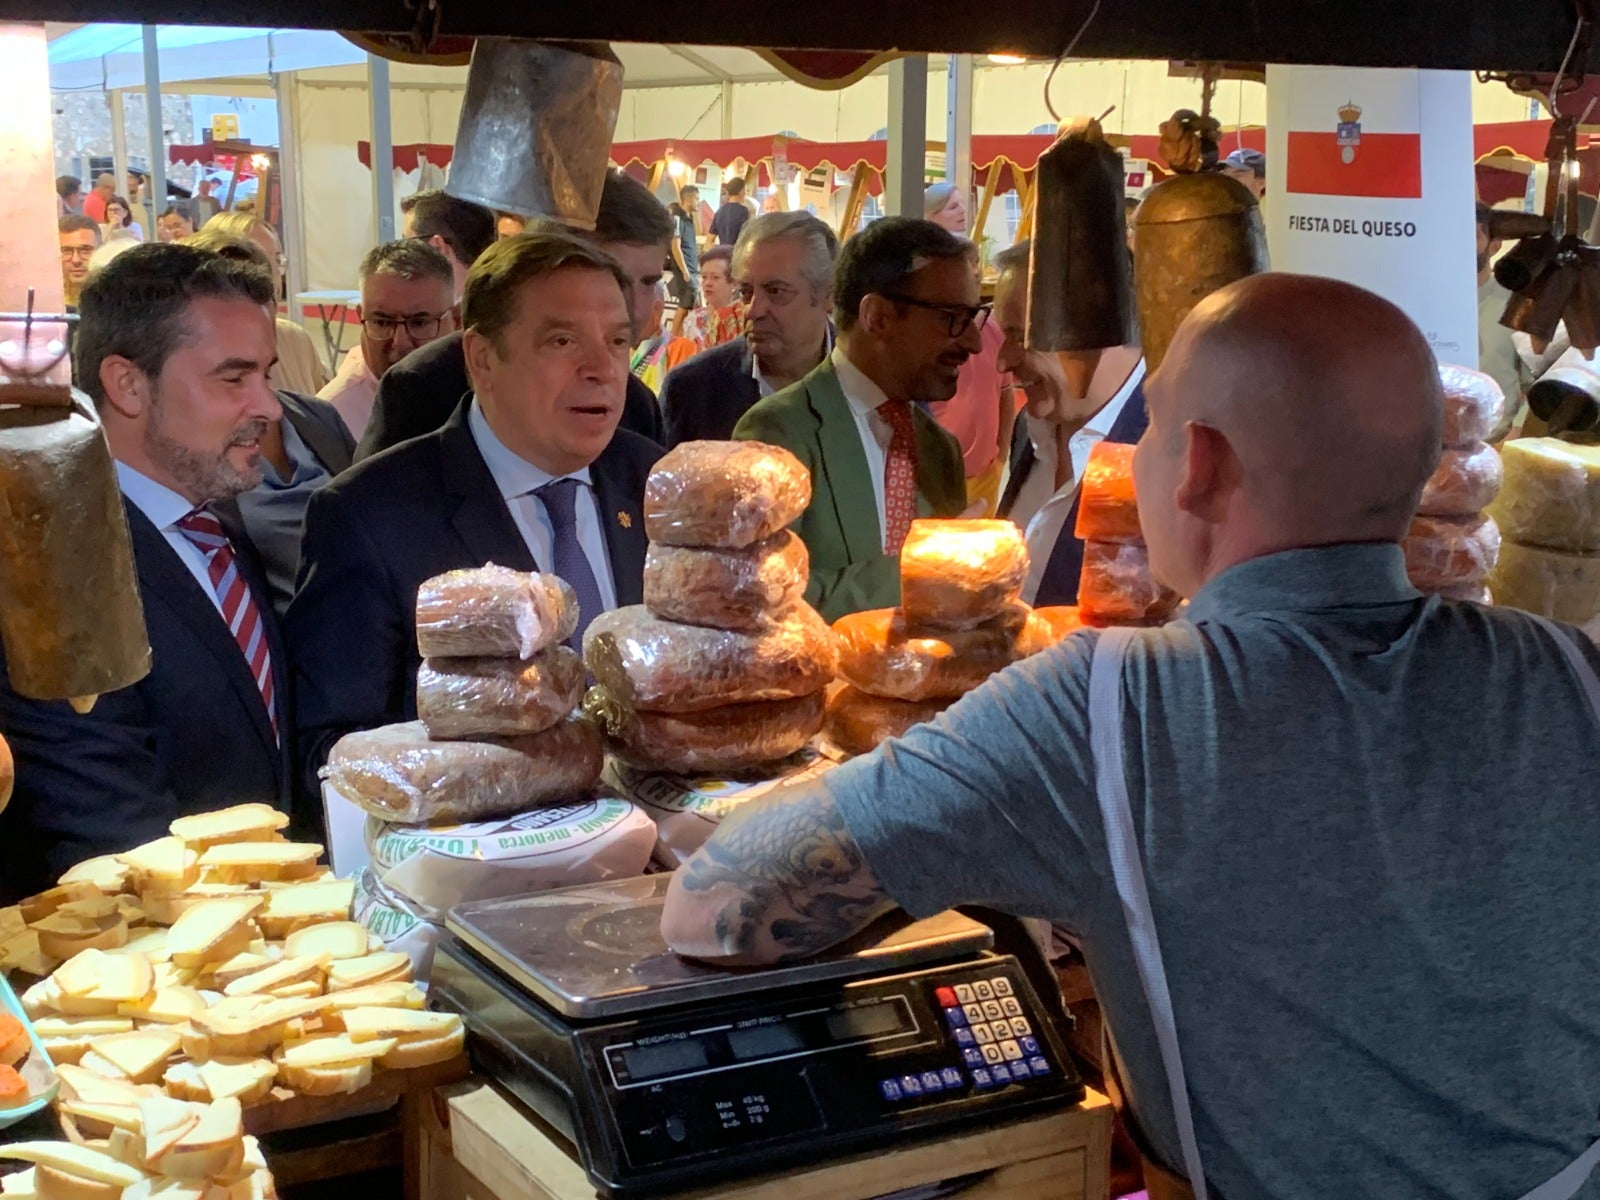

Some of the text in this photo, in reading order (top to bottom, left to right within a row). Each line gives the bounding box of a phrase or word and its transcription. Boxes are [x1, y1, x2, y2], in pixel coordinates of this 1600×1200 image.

[1289, 215, 1417, 237] FIESTA DEL QUESO
[499, 825, 571, 850] menorca
[958, 980, 1009, 1000] 7 8 9
[969, 1000, 1018, 1019] 4 5 6
[978, 1027, 989, 1040] 1
[996, 1023, 1008, 1037] 2
[1014, 1020, 1027, 1033] 3
[986, 1046, 999, 1061] 0
[1024, 1039, 1036, 1052] C
